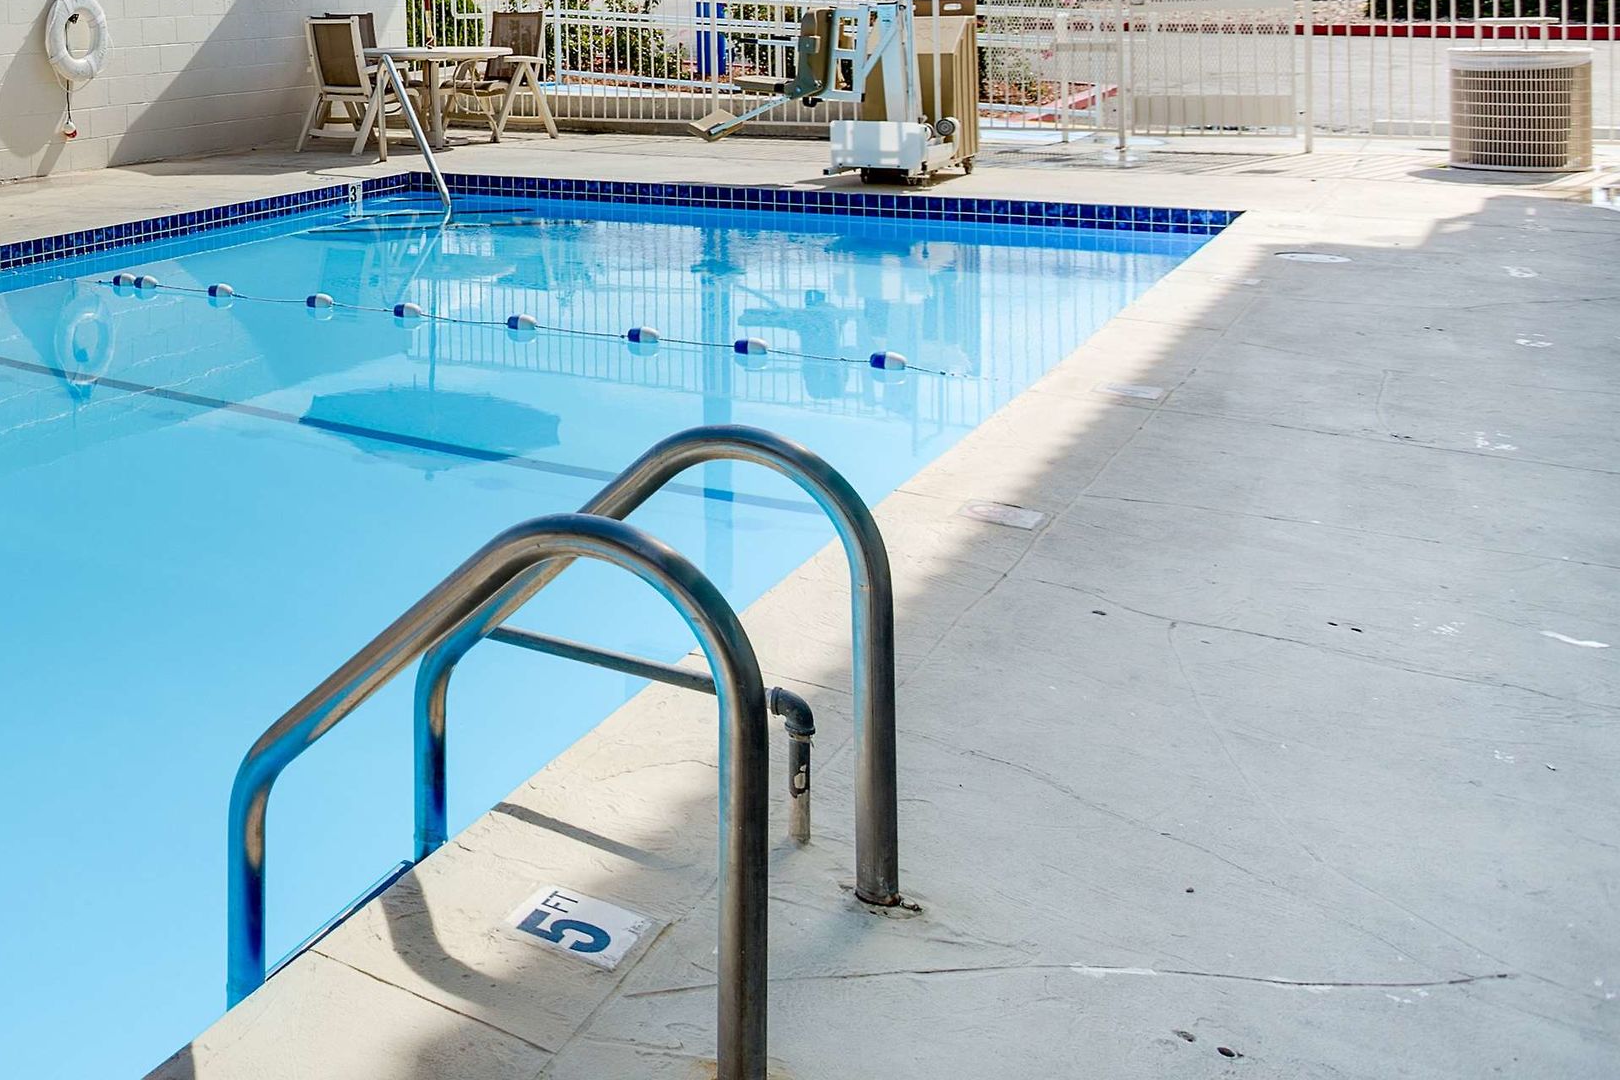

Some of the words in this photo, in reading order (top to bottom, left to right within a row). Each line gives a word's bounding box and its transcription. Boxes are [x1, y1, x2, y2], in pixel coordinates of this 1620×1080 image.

[350, 185, 357, 202] 3
[541, 890, 579, 913] FT
[516, 908, 611, 953] 5
